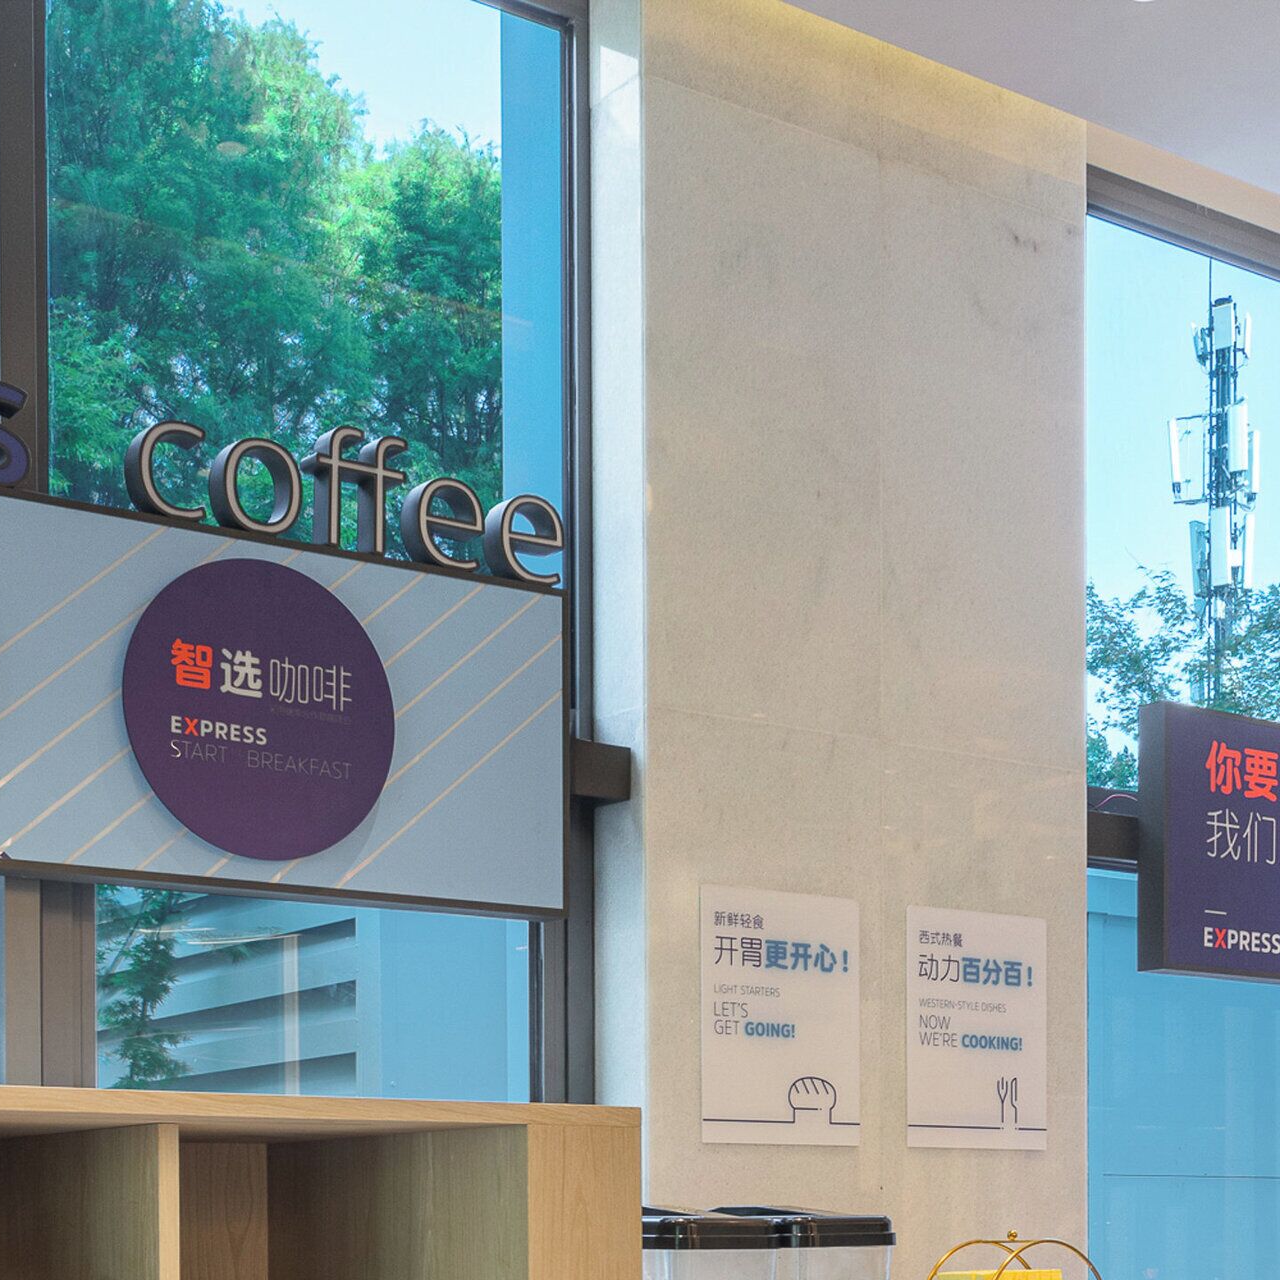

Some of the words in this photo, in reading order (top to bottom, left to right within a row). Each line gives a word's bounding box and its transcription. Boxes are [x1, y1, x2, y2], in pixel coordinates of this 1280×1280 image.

[124, 420, 564, 587] coffee
[171, 638, 353, 711] 智选咖啡
[171, 715, 268, 745] EXPRESS
[170, 739, 228, 763] START
[247, 750, 353, 780] BREAKFAST
[713, 911, 765, 930] 新鲜轻食
[918, 929, 964, 948] 西式热餐
[713, 983, 738, 995] LIGHT
[740, 985, 781, 998] STARTERS
[713, 1001, 749, 1018] LET'S
[918, 997, 980, 1012] WESTERN-STYLE
[981, 1002, 1007, 1013] DISHES
[713, 1019, 740, 1036] GET
[744, 1021, 796, 1038] GOING!
[918, 1014, 951, 1030] NOW
[918, 1031, 958, 1048] WE'RE
[961, 1033, 1024, 1052] COOKING!
